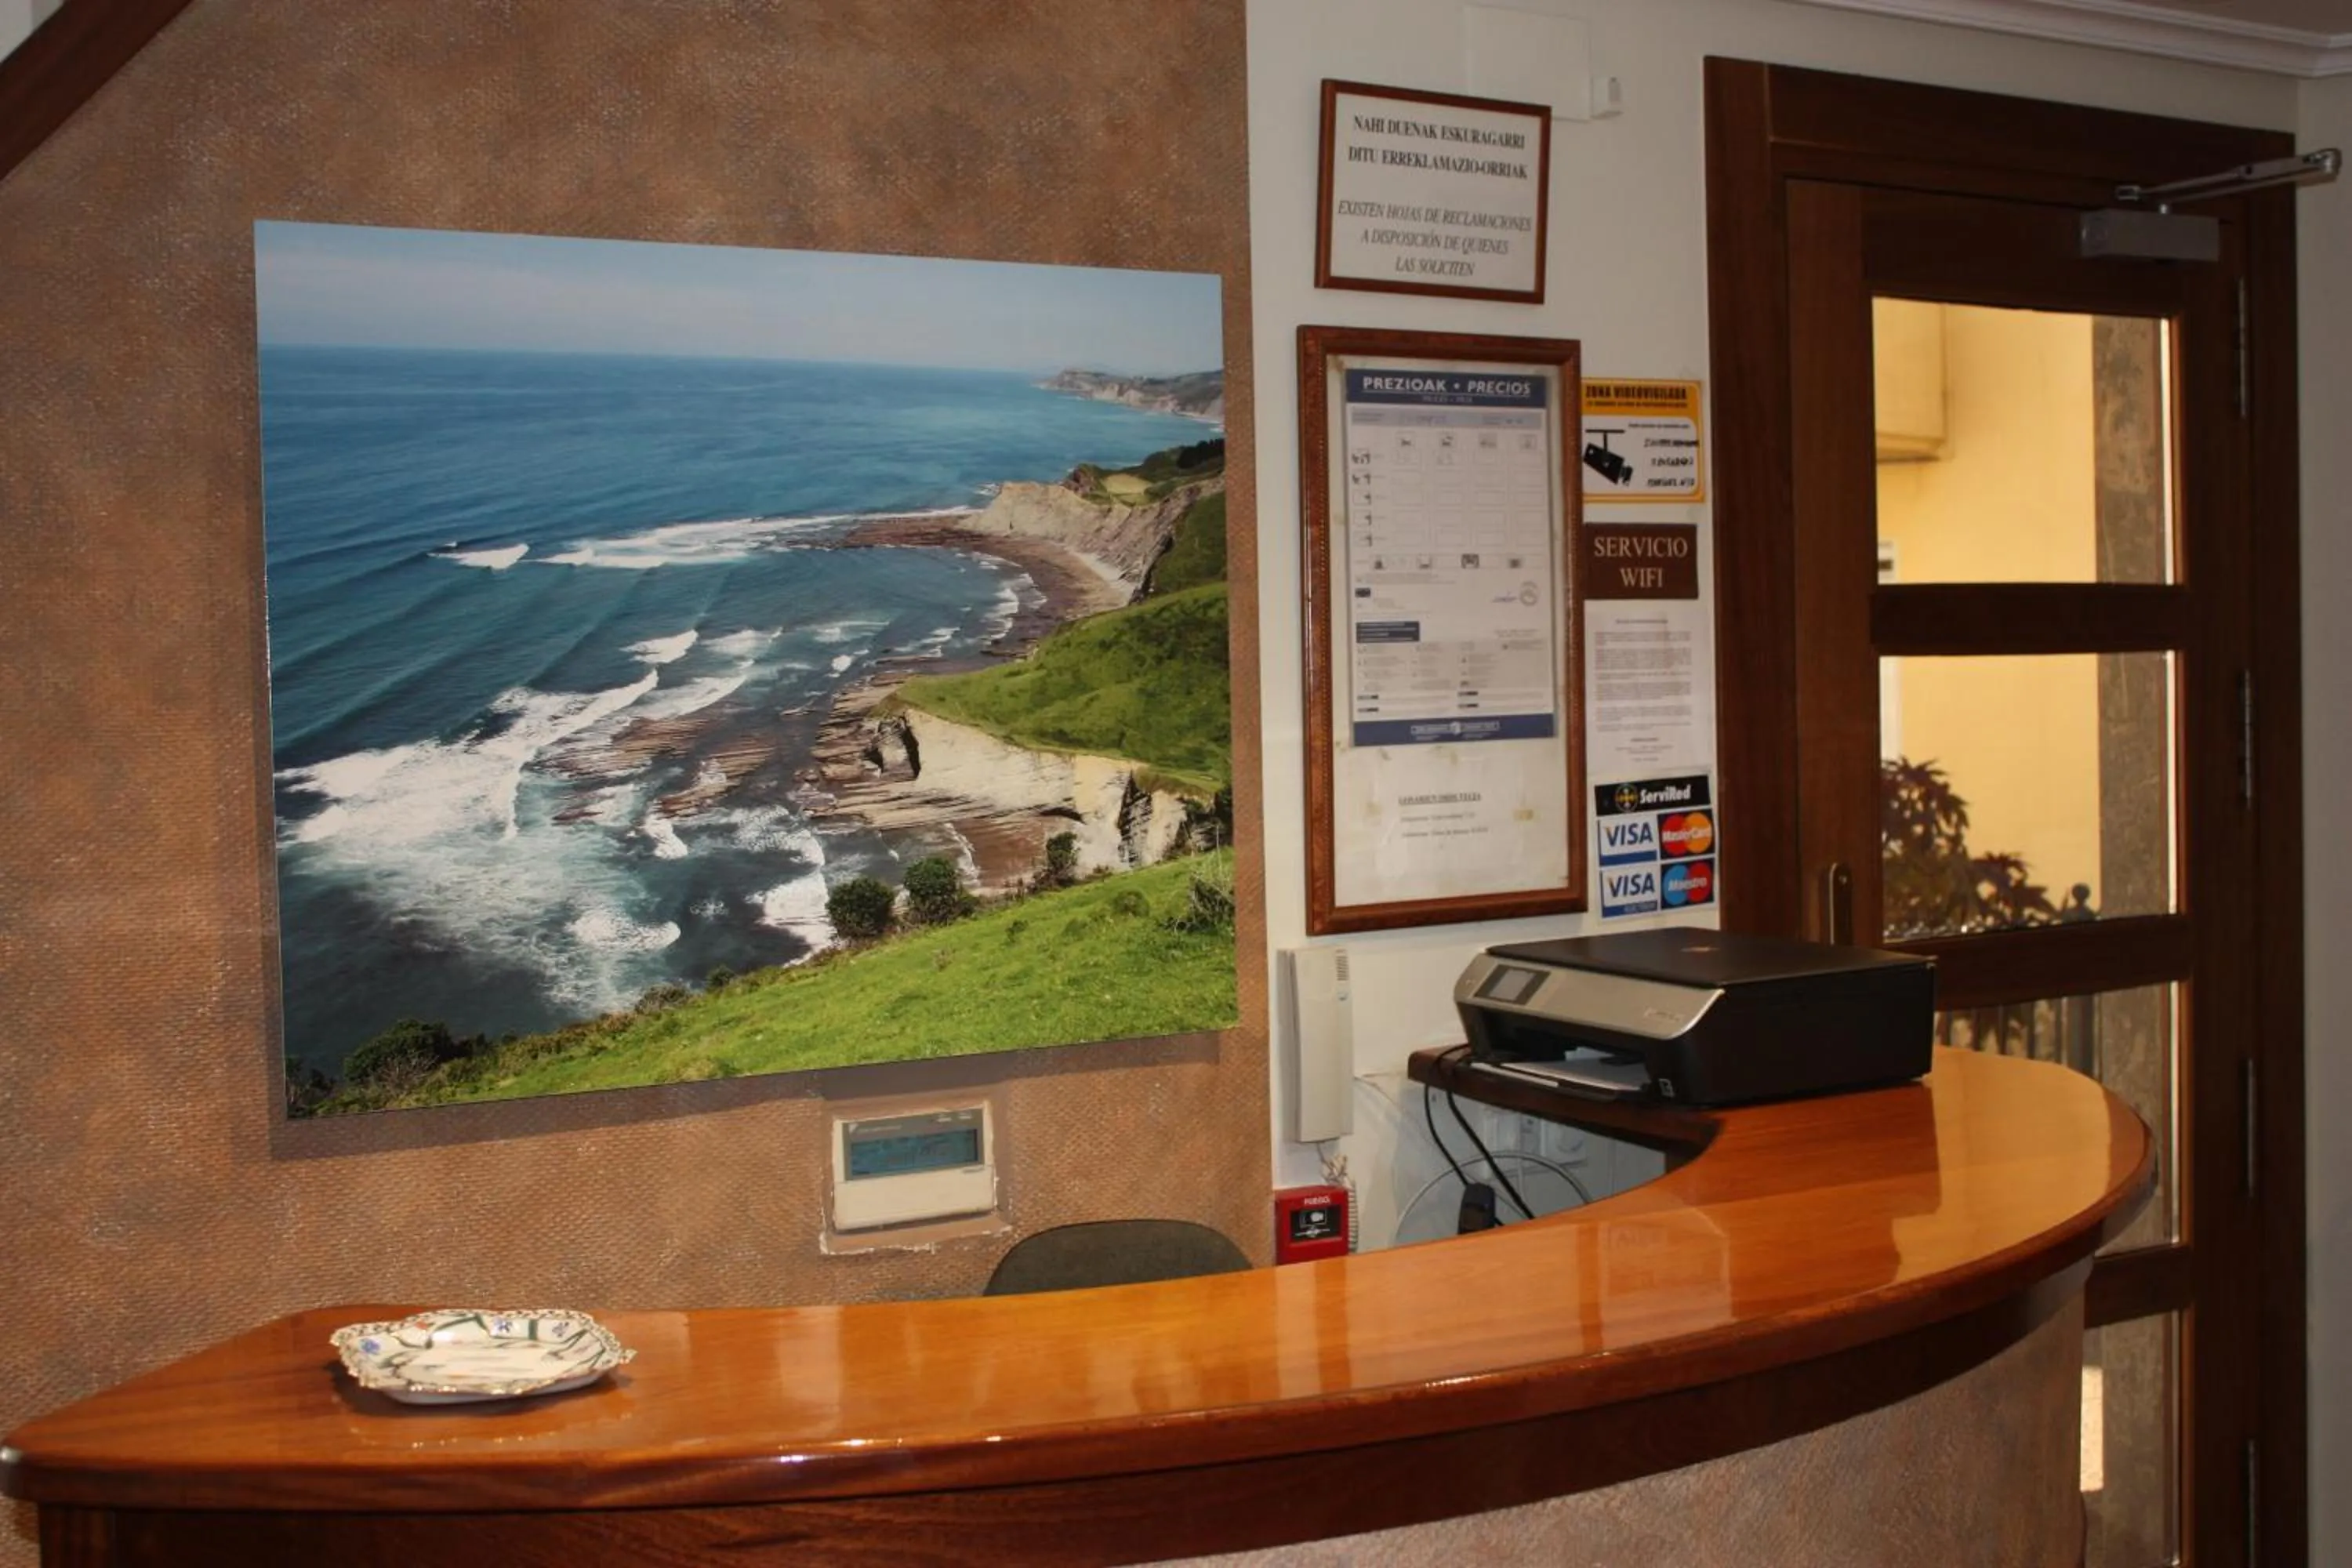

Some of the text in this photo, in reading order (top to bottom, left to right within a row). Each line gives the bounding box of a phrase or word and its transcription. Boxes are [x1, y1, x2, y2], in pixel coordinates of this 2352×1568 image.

[1354, 116, 1526, 149] NAHI DUENAK ESKURAGARRI
[1348, 146, 1528, 180] DITU ERREKLAMAZIO-ORRIAK
[1338, 200, 1533, 232] EXISTEN HOJAS DE RECLAMACIONES
[1444, 234, 1461, 251] DE
[1462, 237, 1509, 256] QUIENES
[1395, 256, 1475, 276] LAS SOLICITEN
[1363, 376, 1532, 395] PREZIOAK PRECIOS
[1593, 536, 1688, 558] SERVICIO
[1620, 567, 1663, 588] WIFI
[1639, 784, 1692, 804] ServiRed
[1604, 821, 1653, 848] VISA
[1608, 873, 1655, 898] VISA
